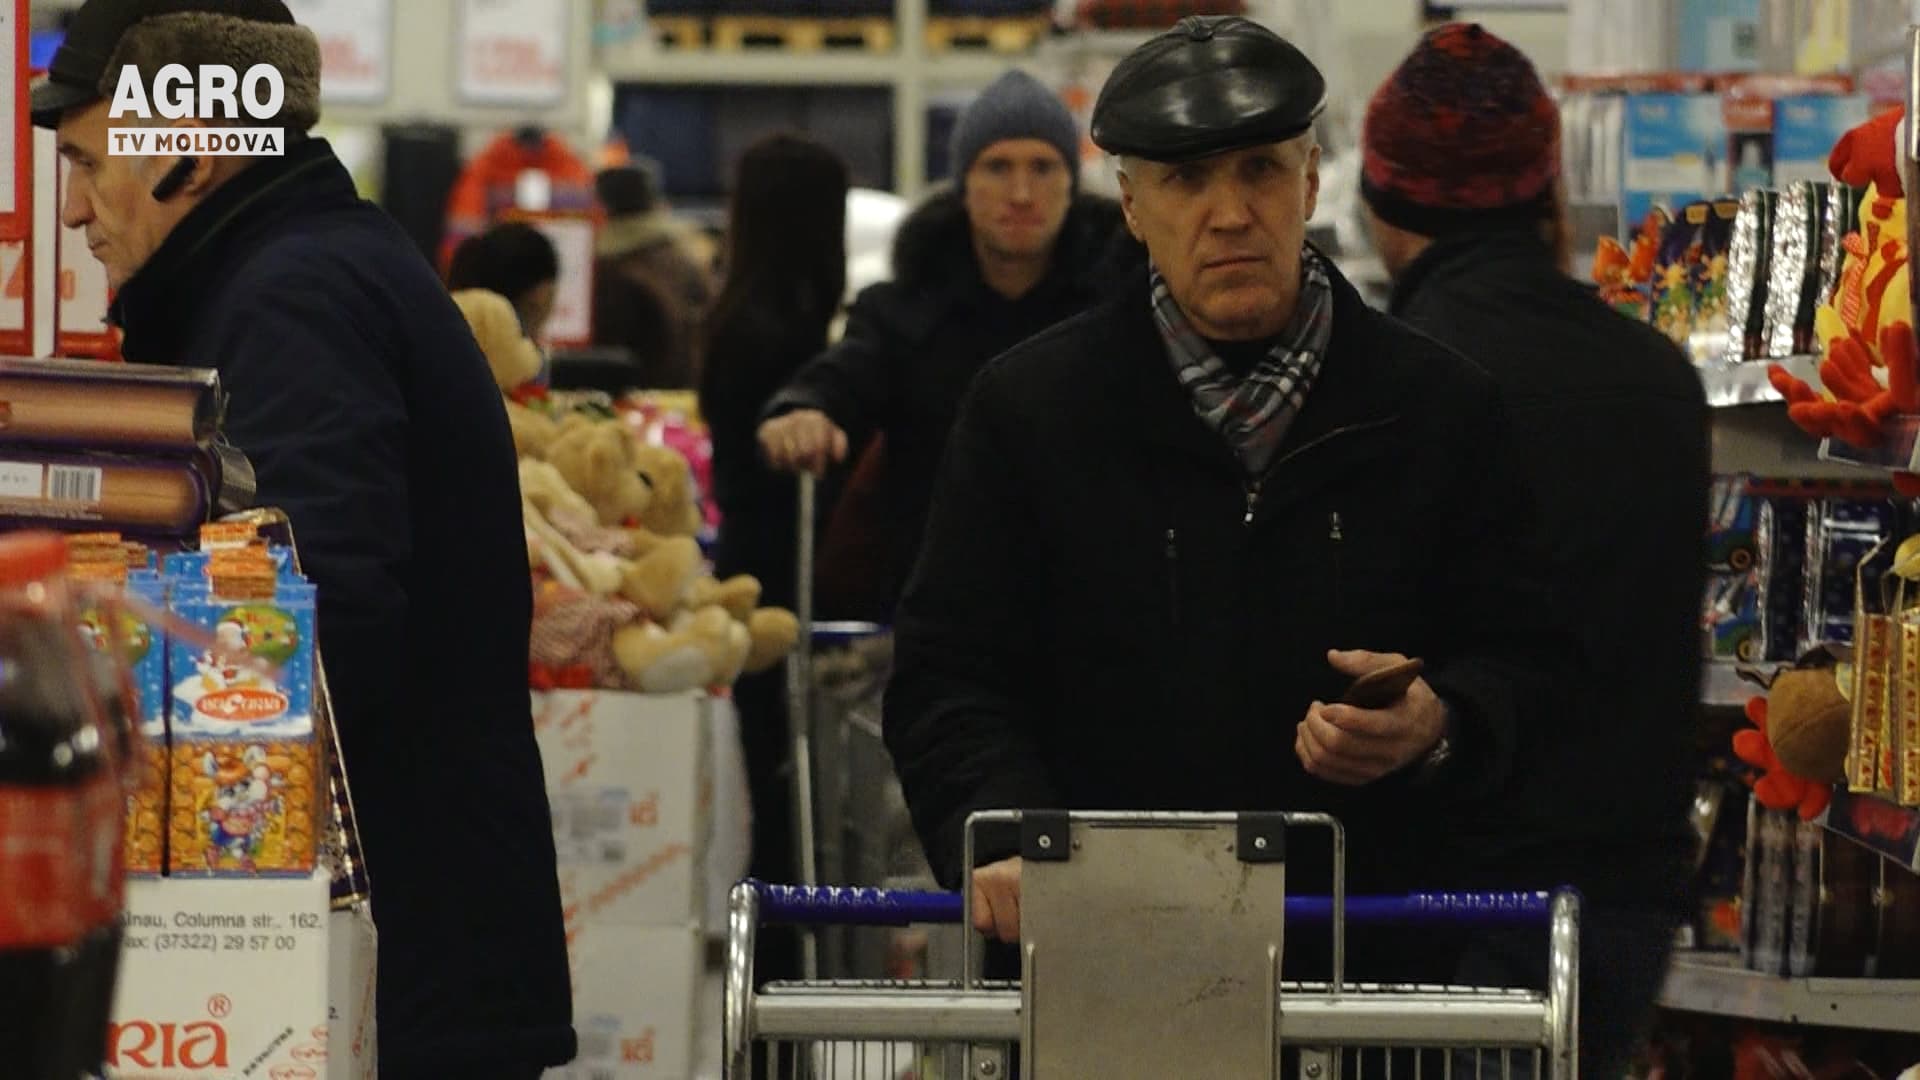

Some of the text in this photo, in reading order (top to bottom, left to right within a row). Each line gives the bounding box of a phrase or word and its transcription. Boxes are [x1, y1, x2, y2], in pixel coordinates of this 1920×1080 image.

[174, 911, 246, 928] Columna
[155, 933, 217, 952] (37322)
[223, 935, 245, 950] 29
[250, 935, 270, 950] 57
[275, 935, 296, 950] 00
